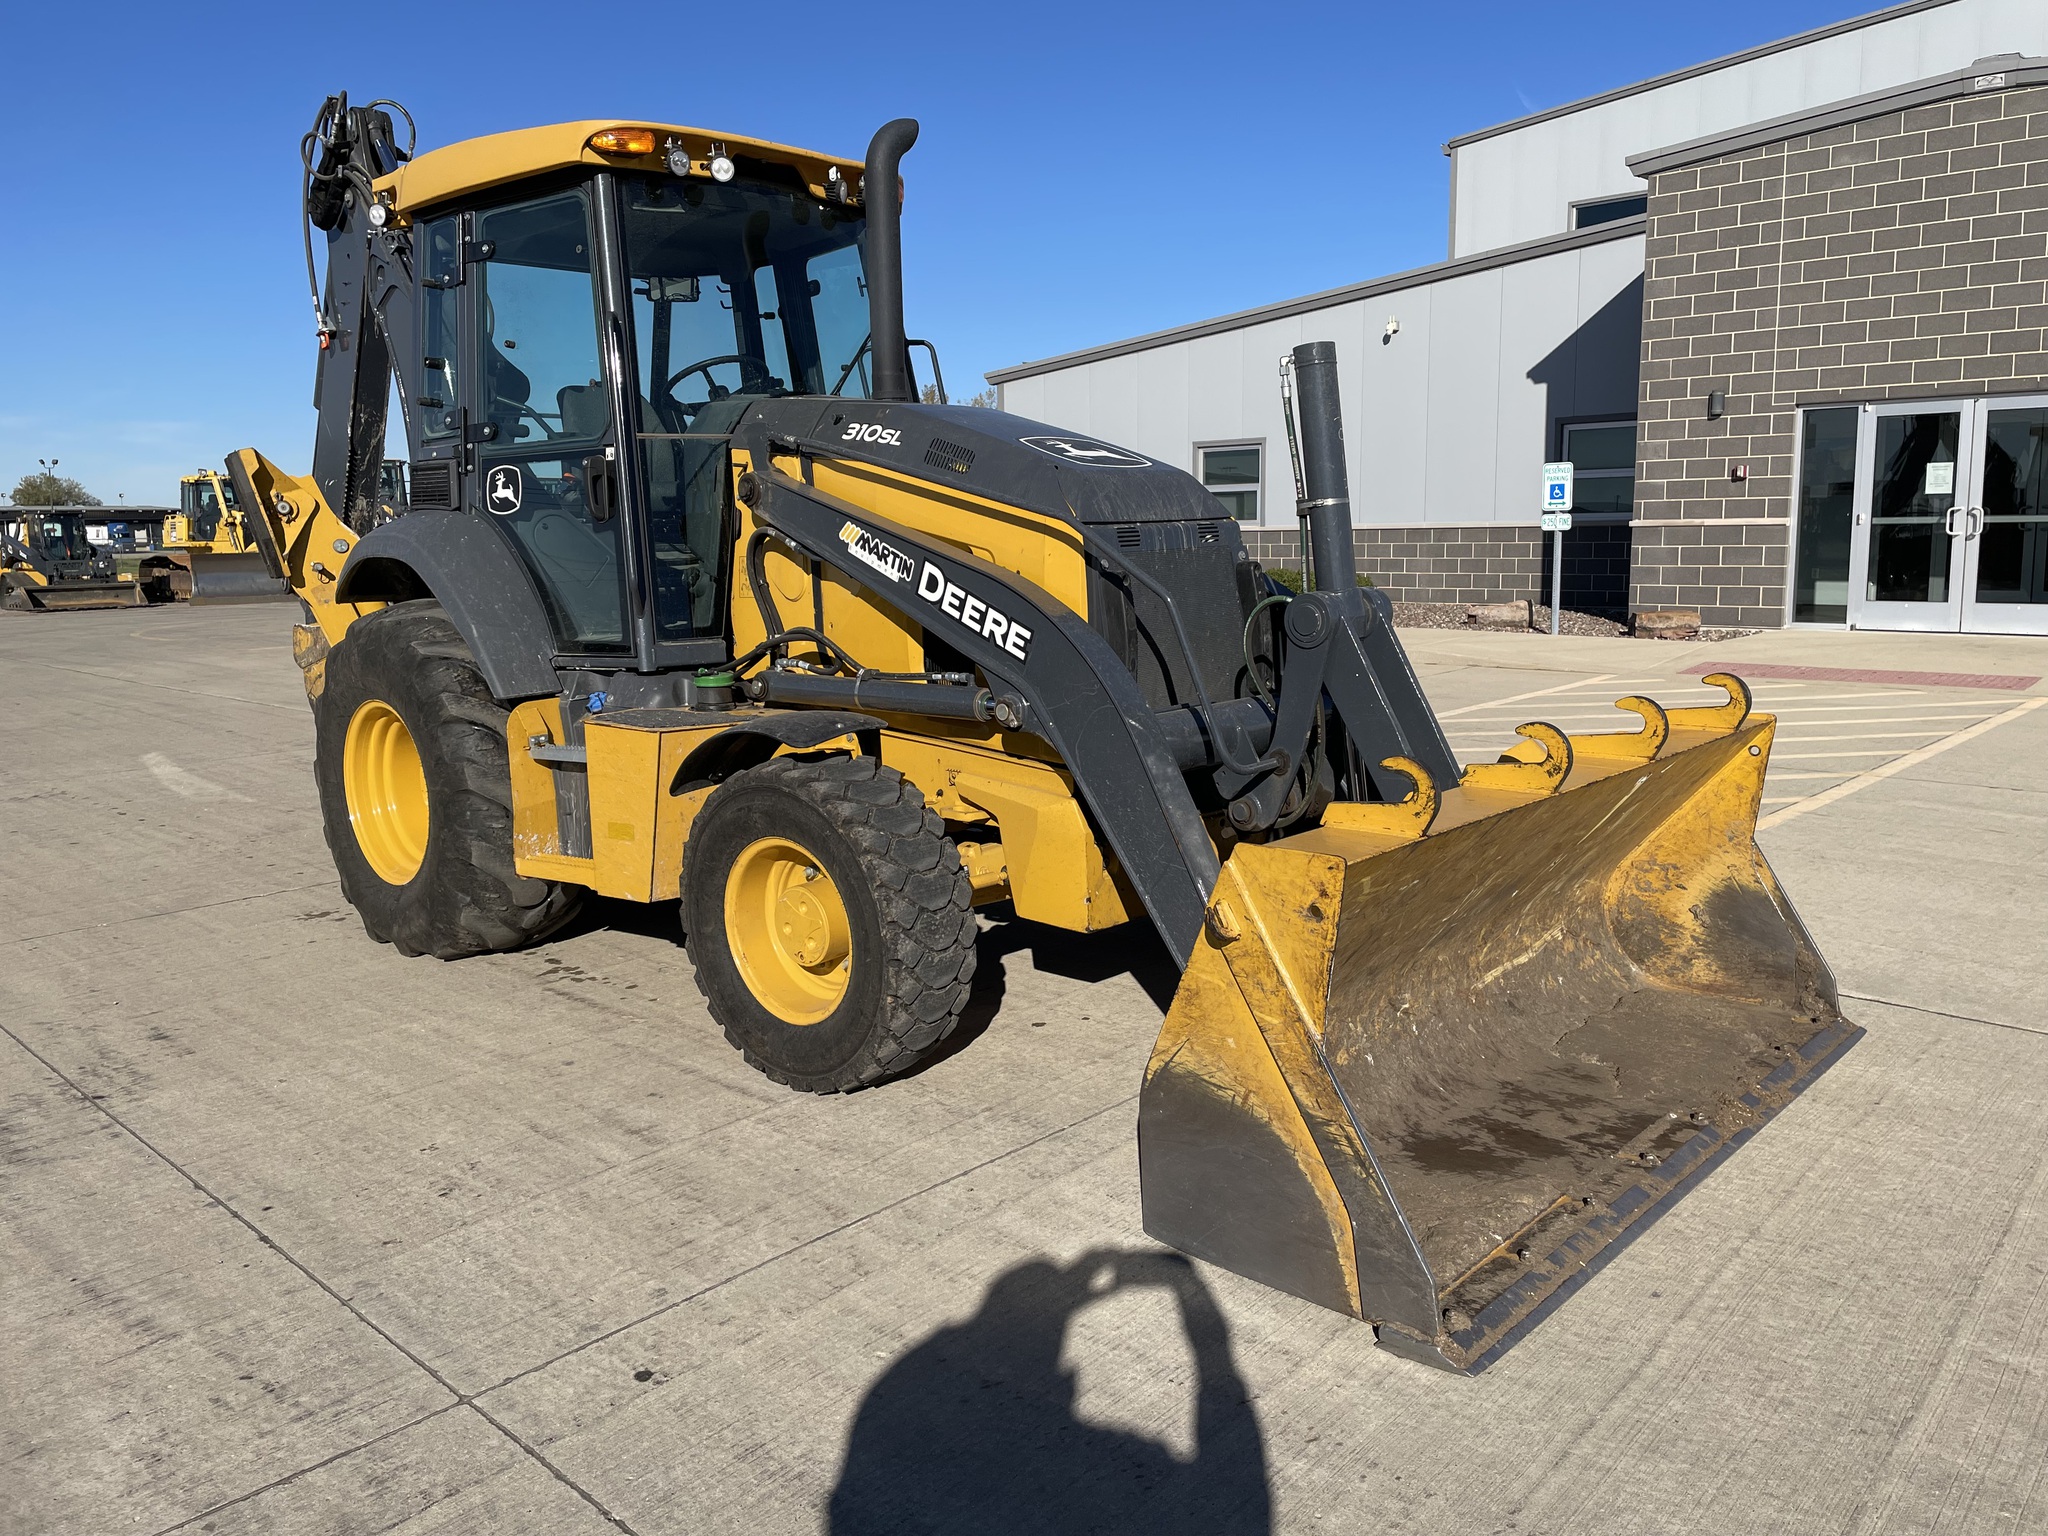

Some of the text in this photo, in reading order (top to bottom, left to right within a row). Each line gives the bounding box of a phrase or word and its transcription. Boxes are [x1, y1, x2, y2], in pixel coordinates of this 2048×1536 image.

[841, 423, 902, 446] 310SL
[1559, 517, 1570, 526] FINE
[855, 531, 914, 580] MARTIN
[918, 561, 1032, 661] DEERE
